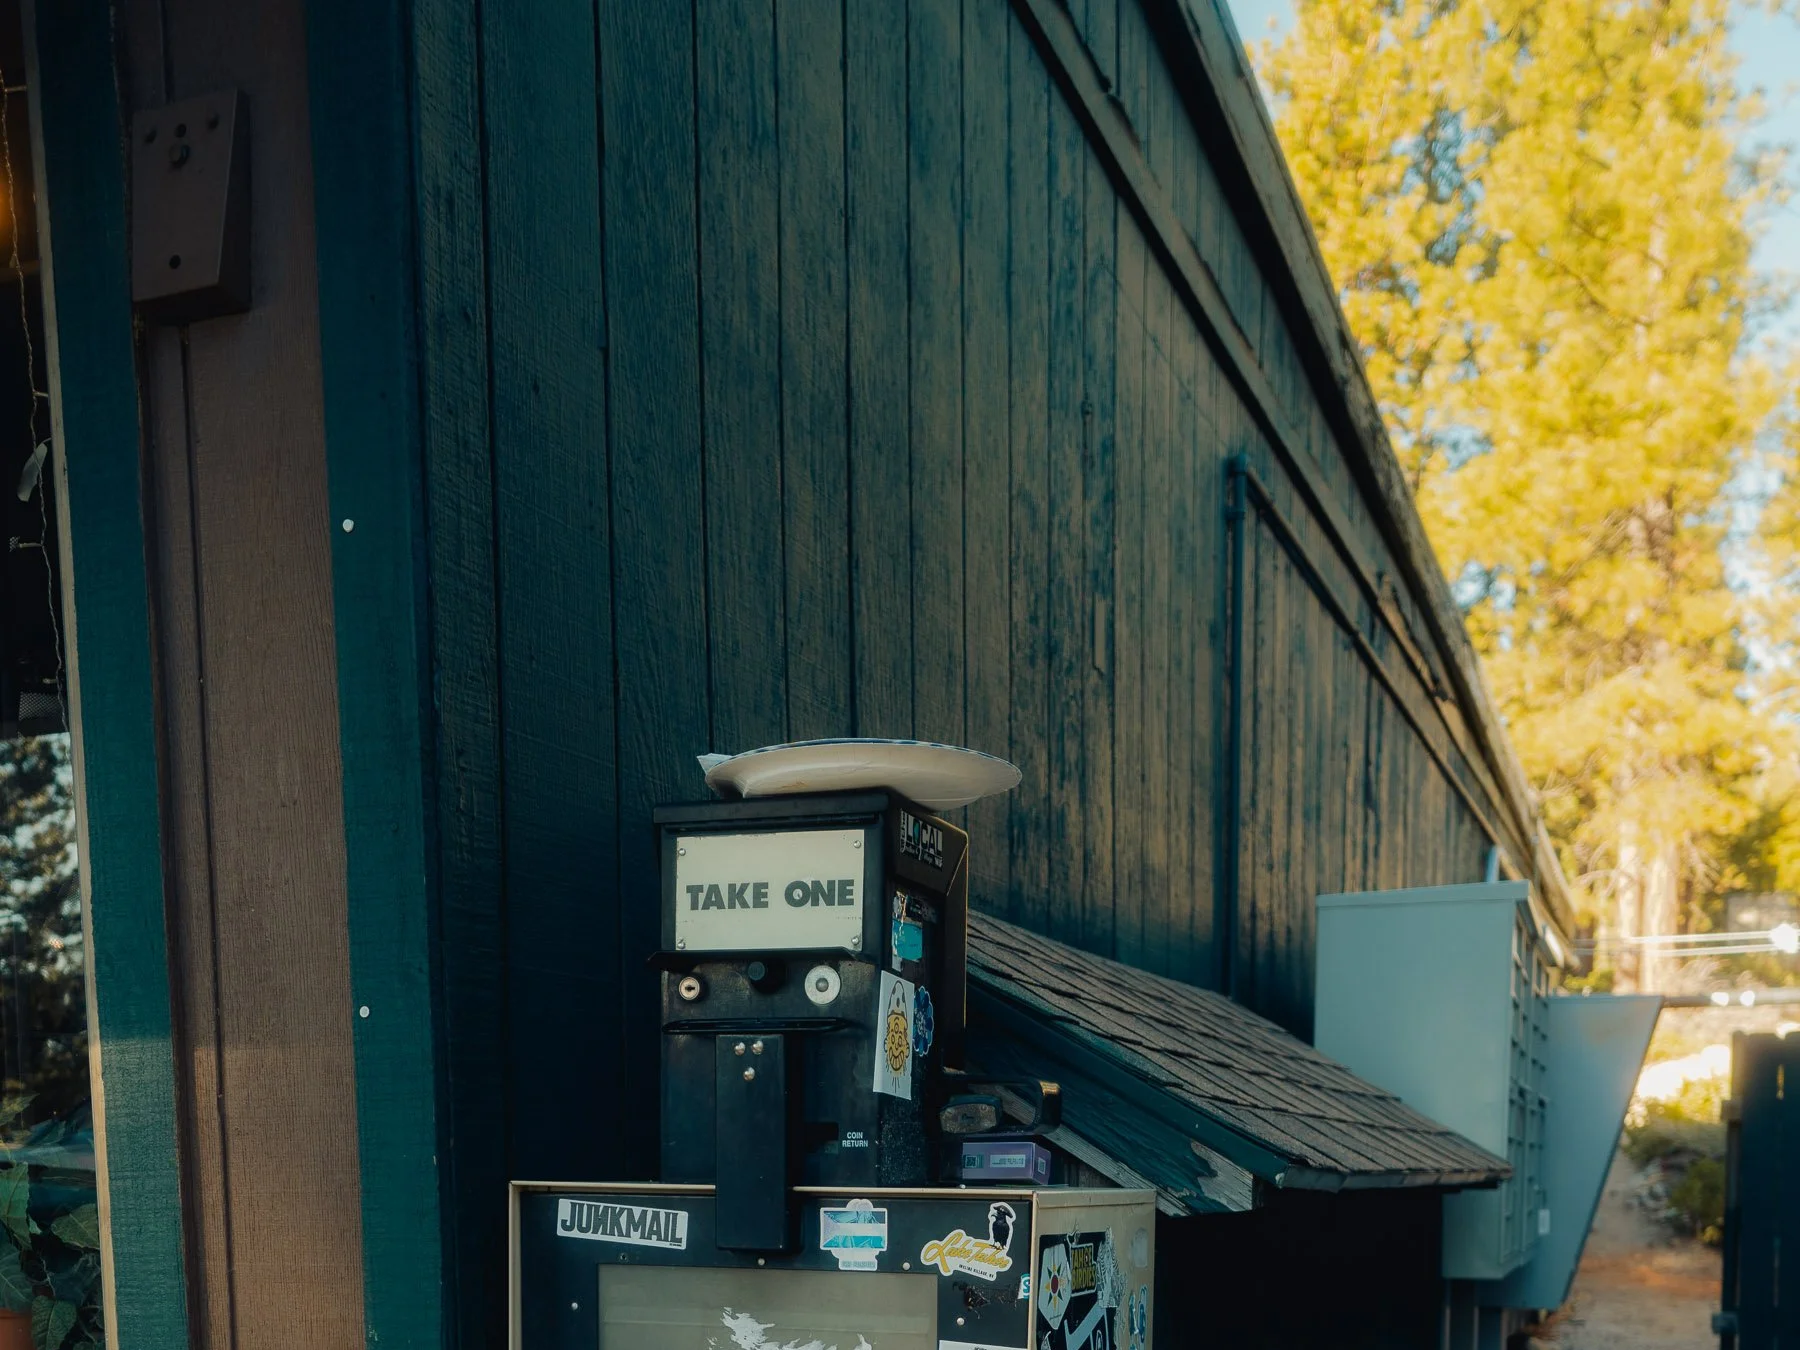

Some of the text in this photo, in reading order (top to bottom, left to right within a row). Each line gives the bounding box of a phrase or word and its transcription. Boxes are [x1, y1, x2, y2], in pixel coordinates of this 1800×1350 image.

[907, 814, 943, 857] LOCAL
[686, 879, 855, 911] TAKE ONE
[842, 1139, 869, 1148] RETURN
[846, 1131, 864, 1140] COIN
[561, 1201, 683, 1244] JUNKMAIL
[923, 1232, 1010, 1273] Lake Tahoe
